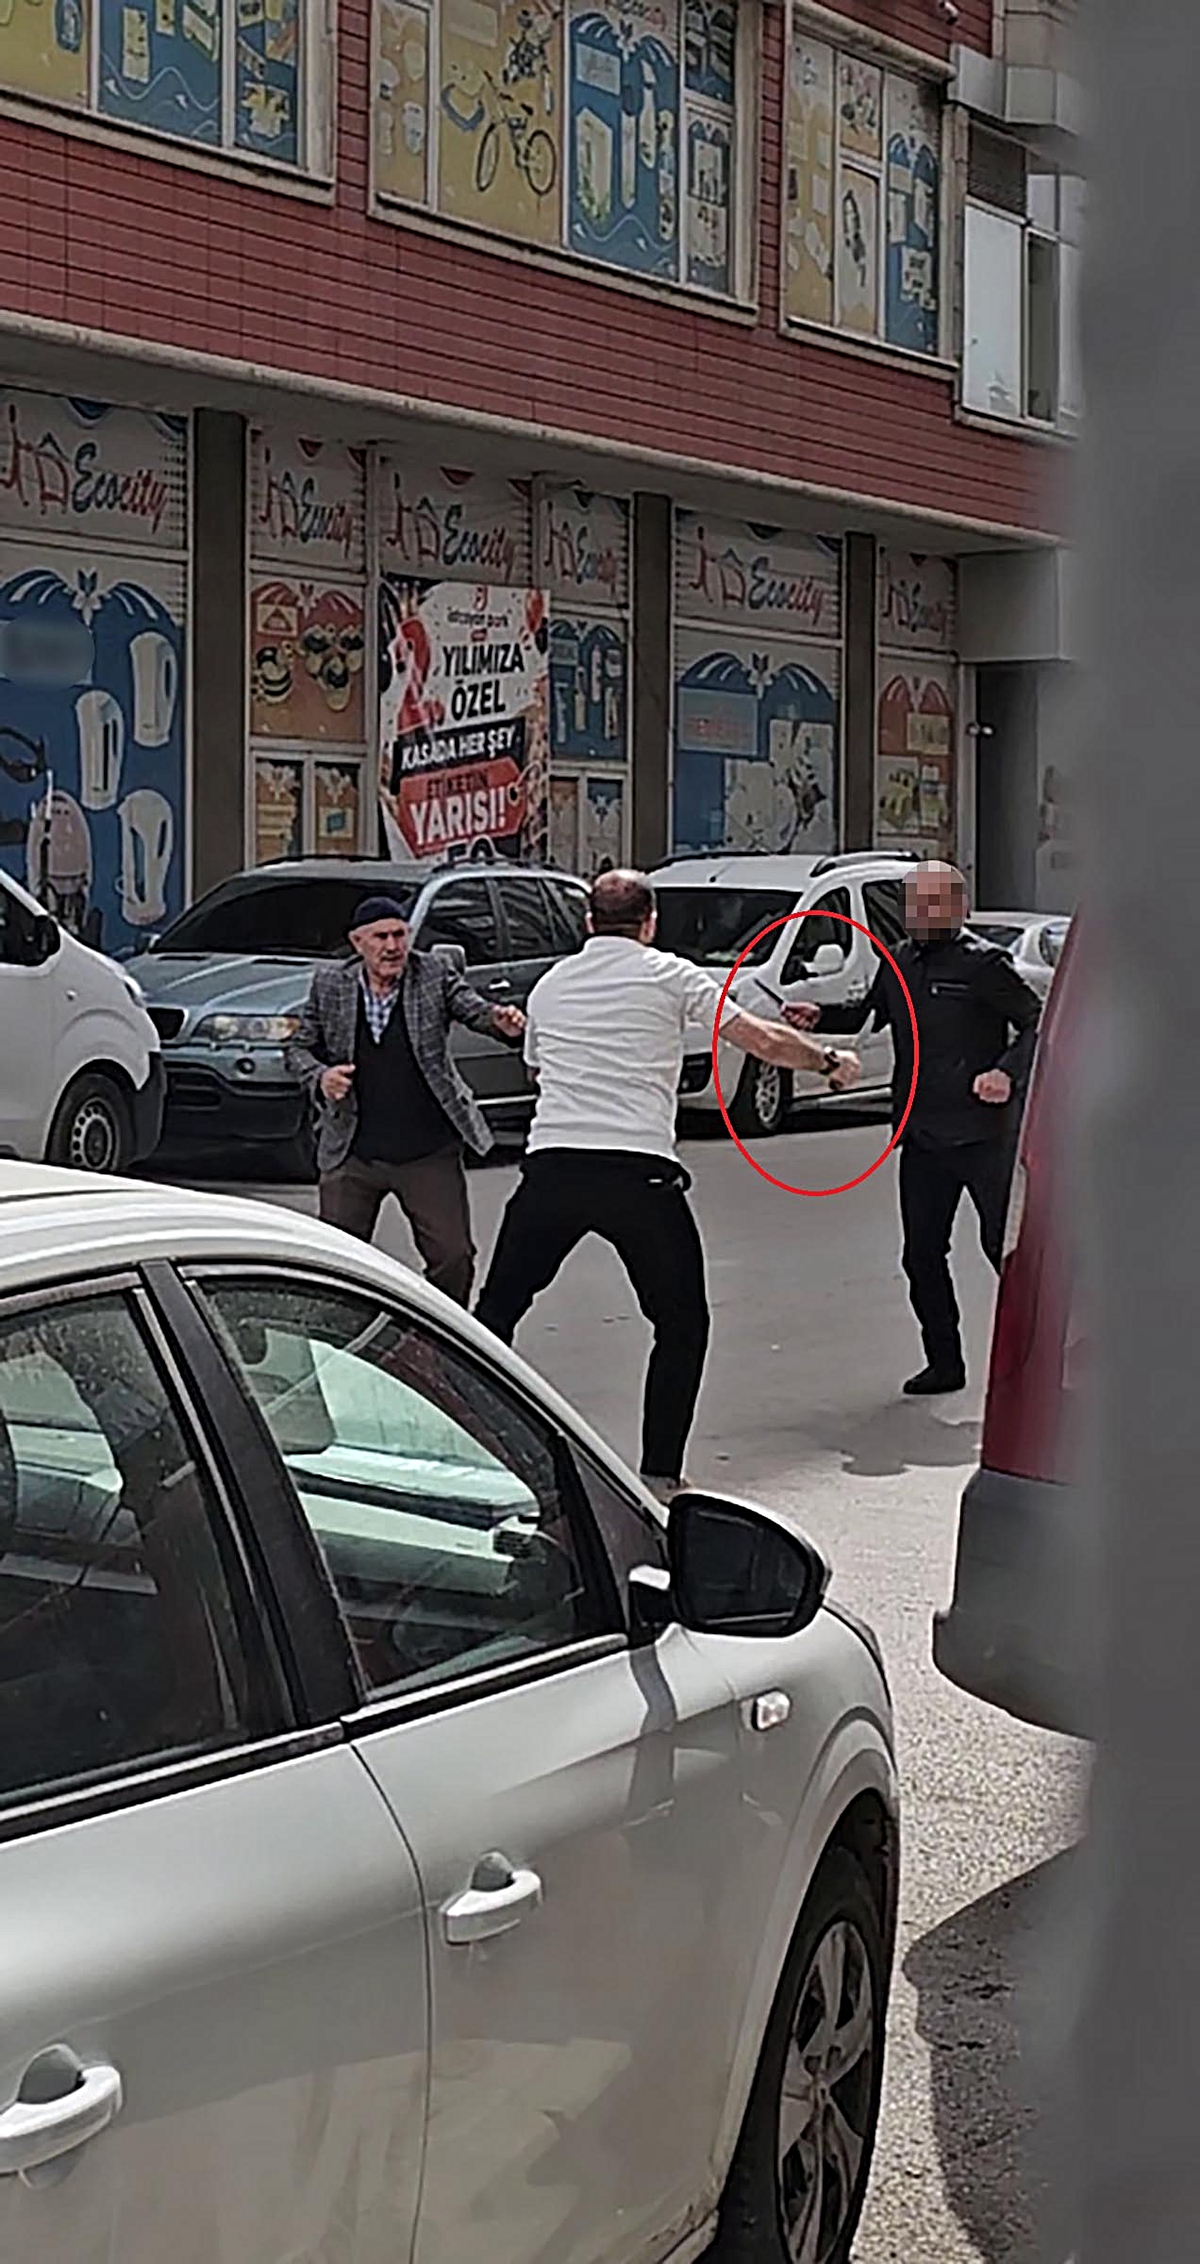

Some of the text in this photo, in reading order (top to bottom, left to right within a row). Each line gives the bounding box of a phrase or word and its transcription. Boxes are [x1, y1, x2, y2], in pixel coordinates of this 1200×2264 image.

[72, 442, 168, 534] Ecocity
[442, 643, 525, 677] YILIMIZA
[451, 679, 506, 721] ÖZEL
[401, 725, 516, 770] KASADA HER ŞEY
[410, 786, 506, 845] YARISI!
